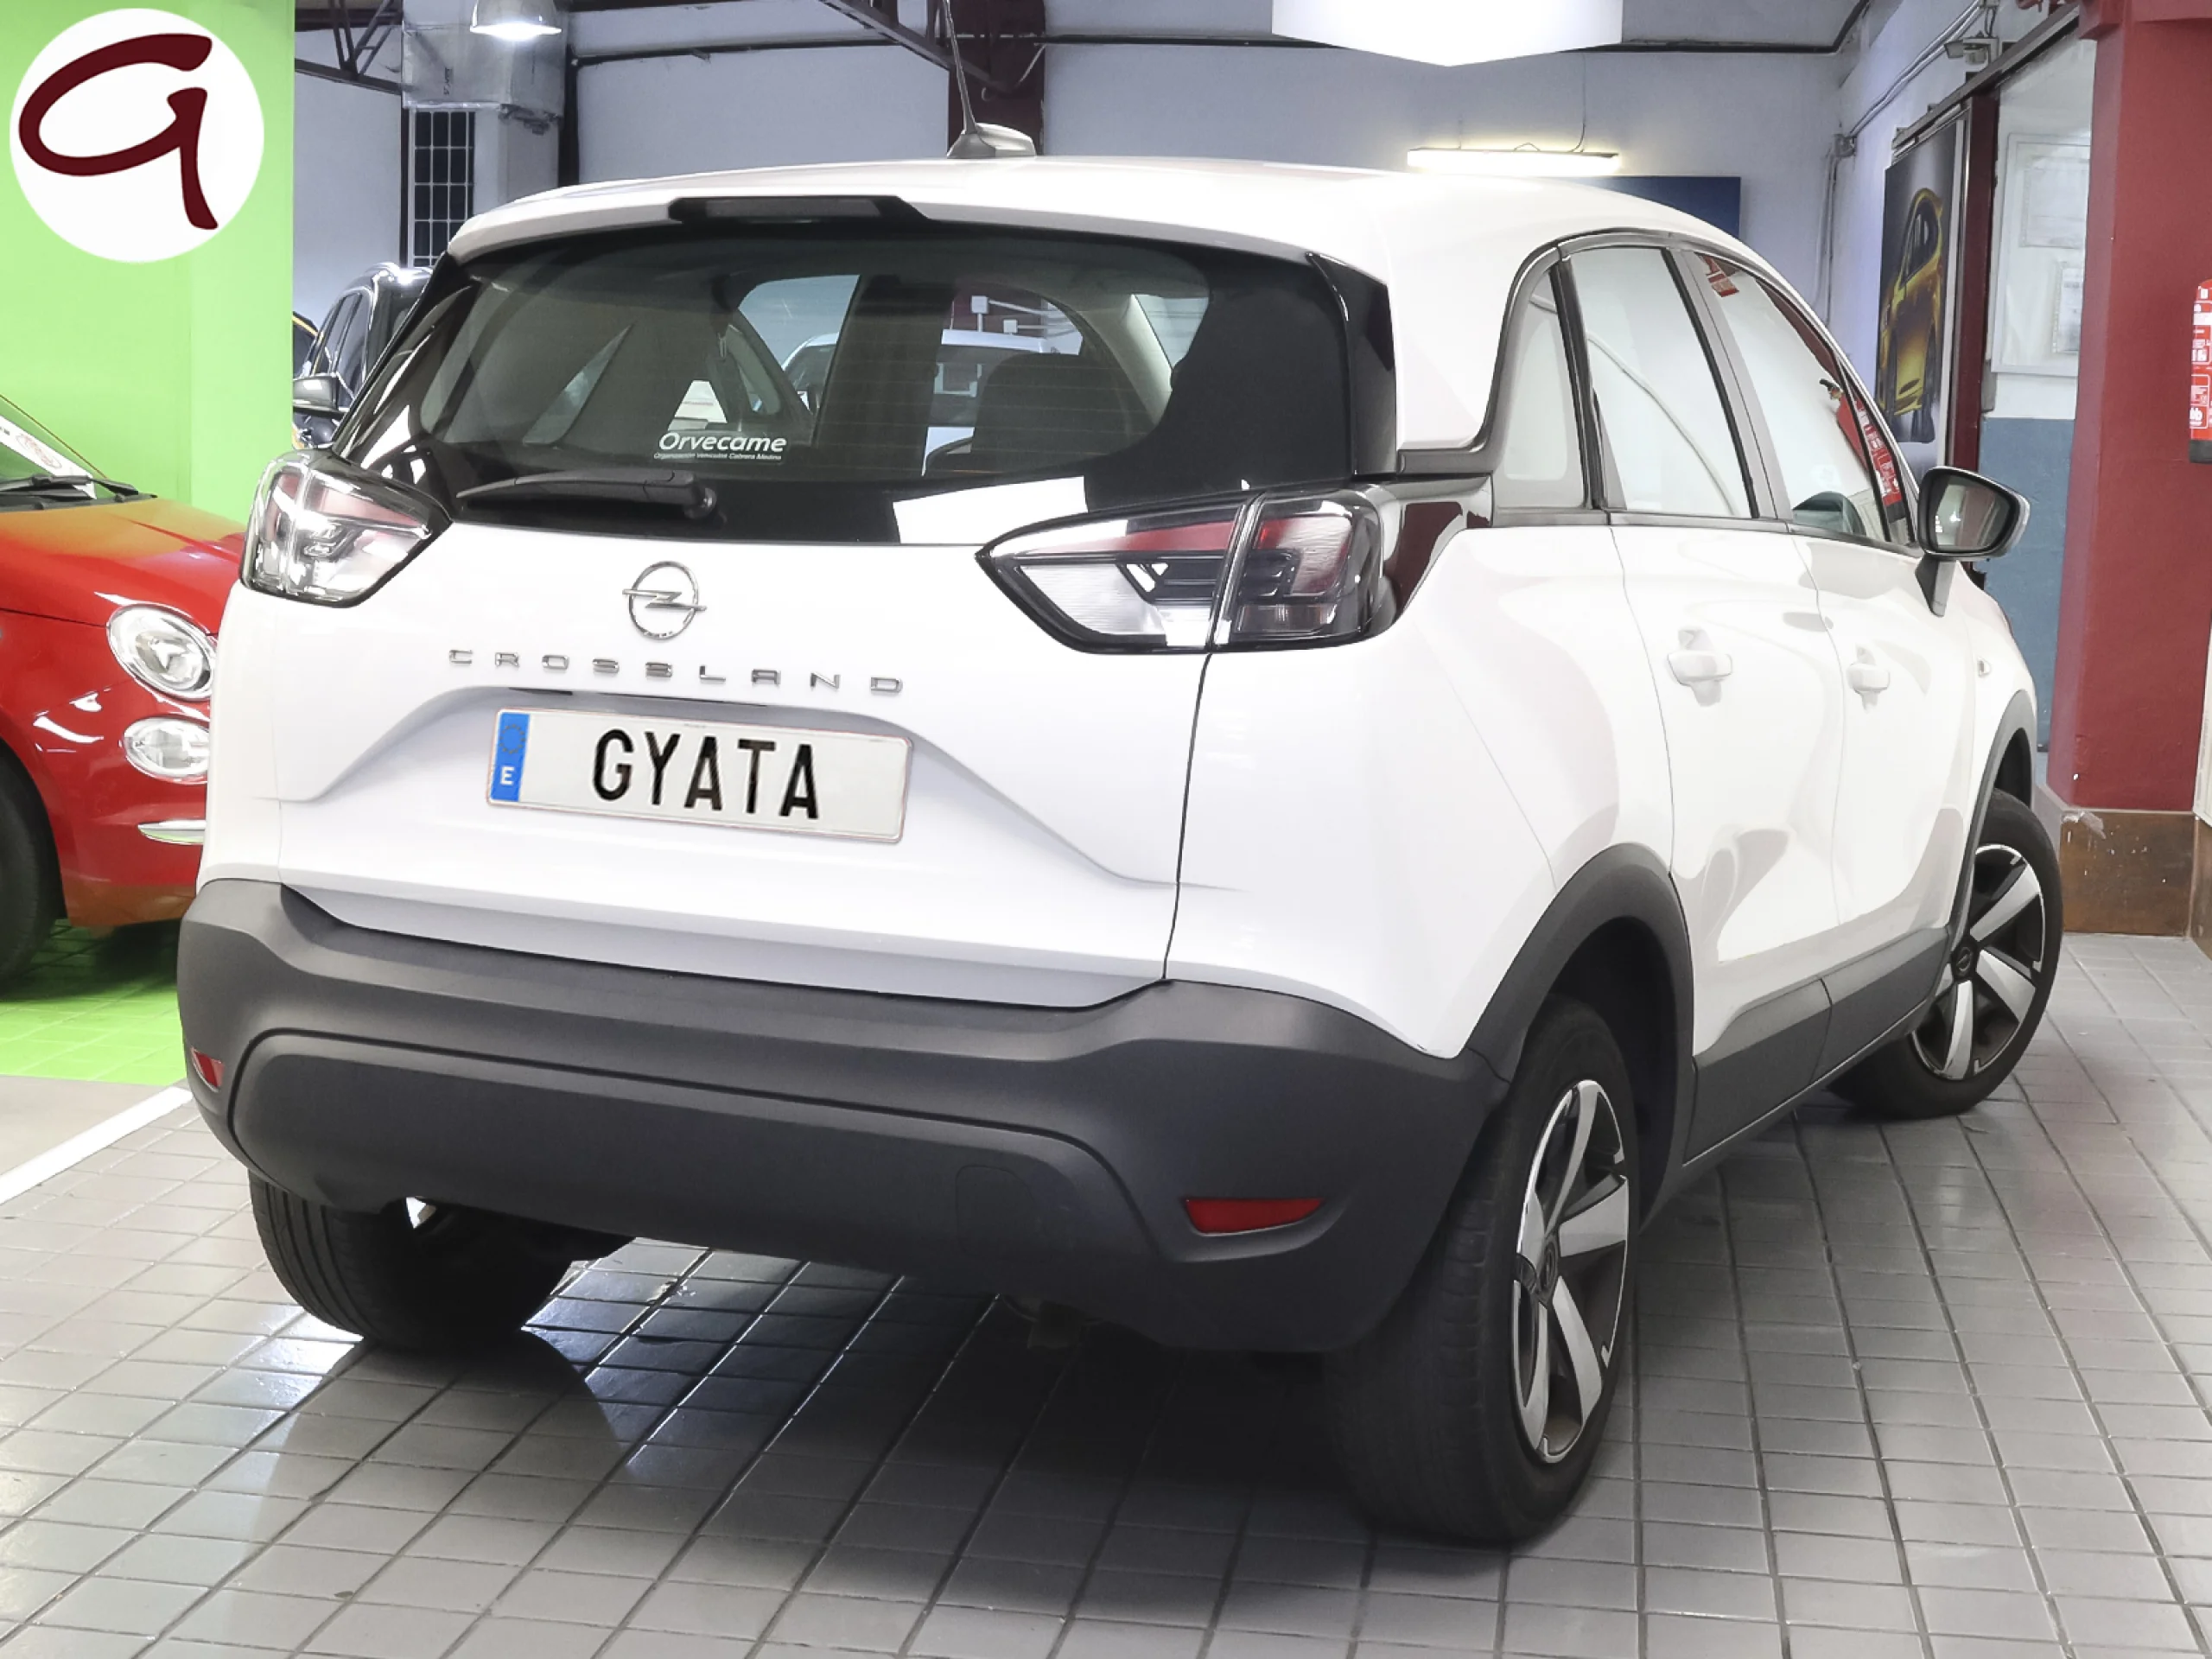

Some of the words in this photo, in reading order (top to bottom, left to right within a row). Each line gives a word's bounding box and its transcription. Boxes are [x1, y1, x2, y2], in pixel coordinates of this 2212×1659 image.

[658, 432, 787, 452] Orvecame
[448, 649, 904, 694] CROSSLAND
[499, 766, 515, 785] E
[593, 728, 819, 820] GYATA
